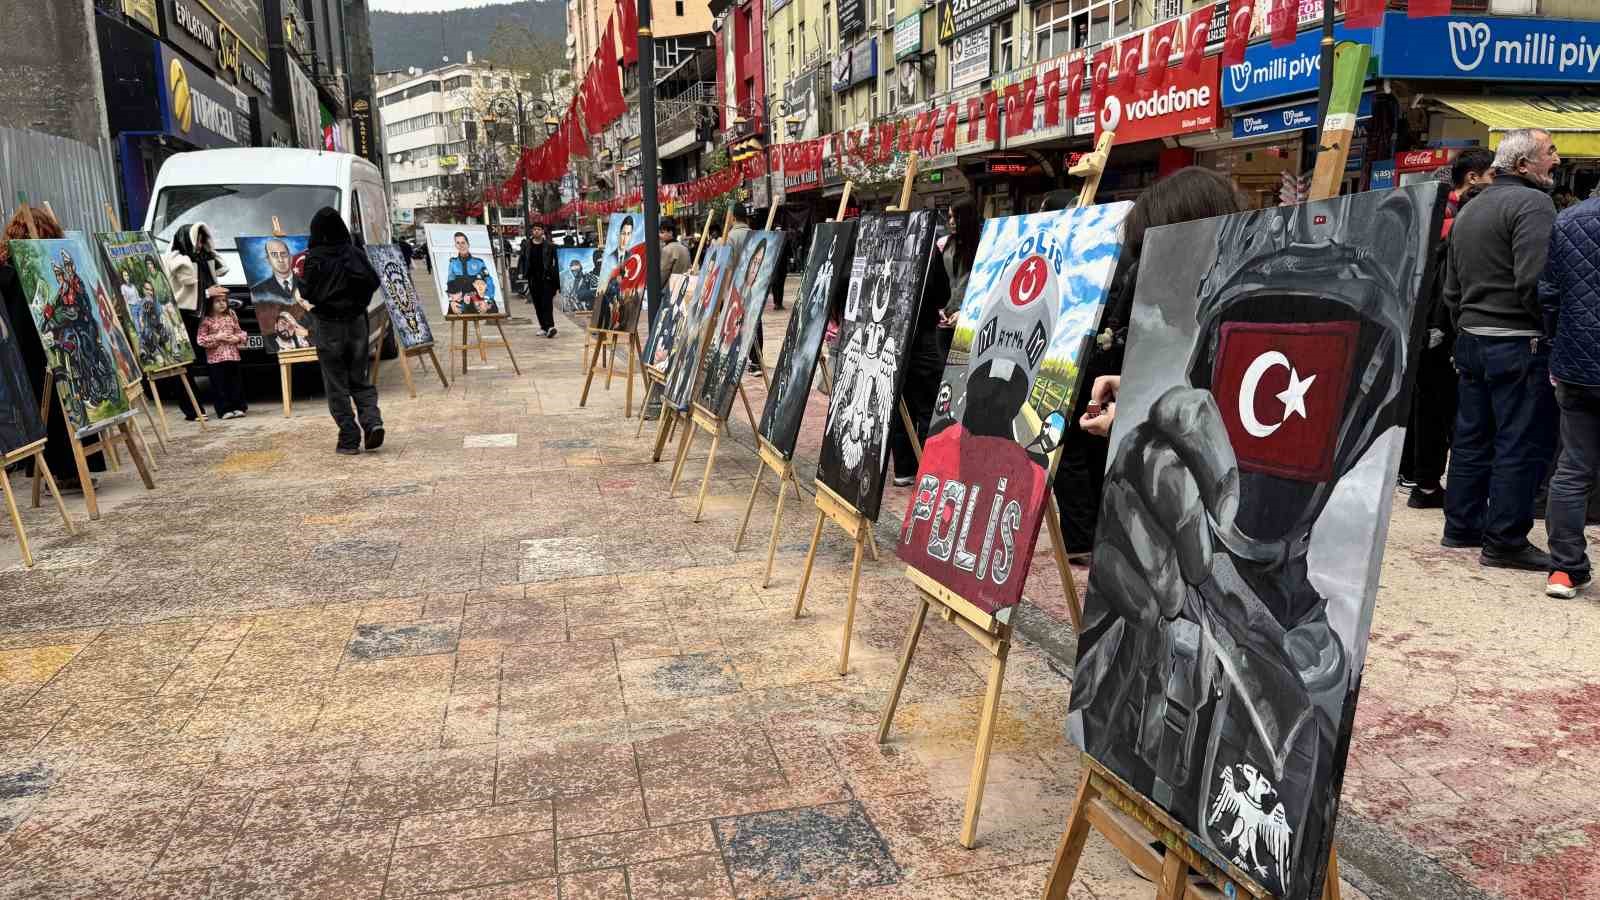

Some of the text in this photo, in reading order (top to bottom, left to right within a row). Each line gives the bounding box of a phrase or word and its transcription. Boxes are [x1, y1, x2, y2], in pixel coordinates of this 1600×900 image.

[1494, 33, 1556, 64] milli
[1253, 58, 1287, 84] milli
[189, 87, 238, 143] TURKCELL
[1125, 85, 1210, 121] vodafone
[904, 474, 1022, 585] POLİS
